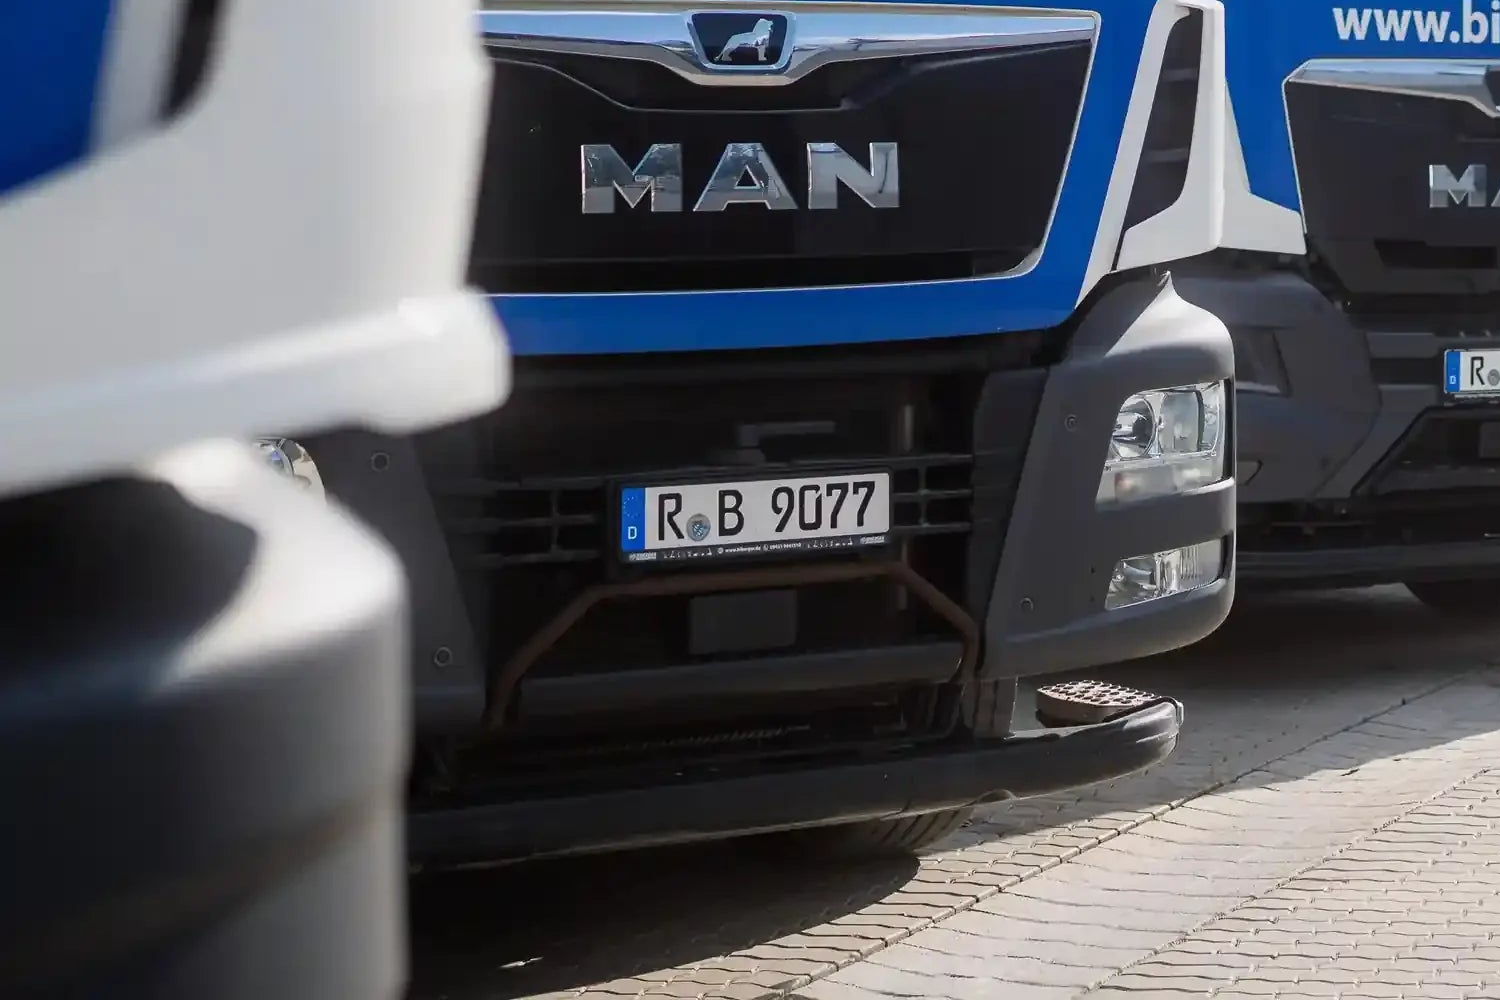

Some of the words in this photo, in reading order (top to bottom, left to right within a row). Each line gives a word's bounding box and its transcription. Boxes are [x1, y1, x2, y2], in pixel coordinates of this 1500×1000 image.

[580, 141, 900, 214] MAN
[1470, 356, 1485, 385] R
[627, 526, 638, 540] D
[658, 492, 685, 541] R
[718, 489, 745, 537] B
[771, 480, 876, 533] 9077
